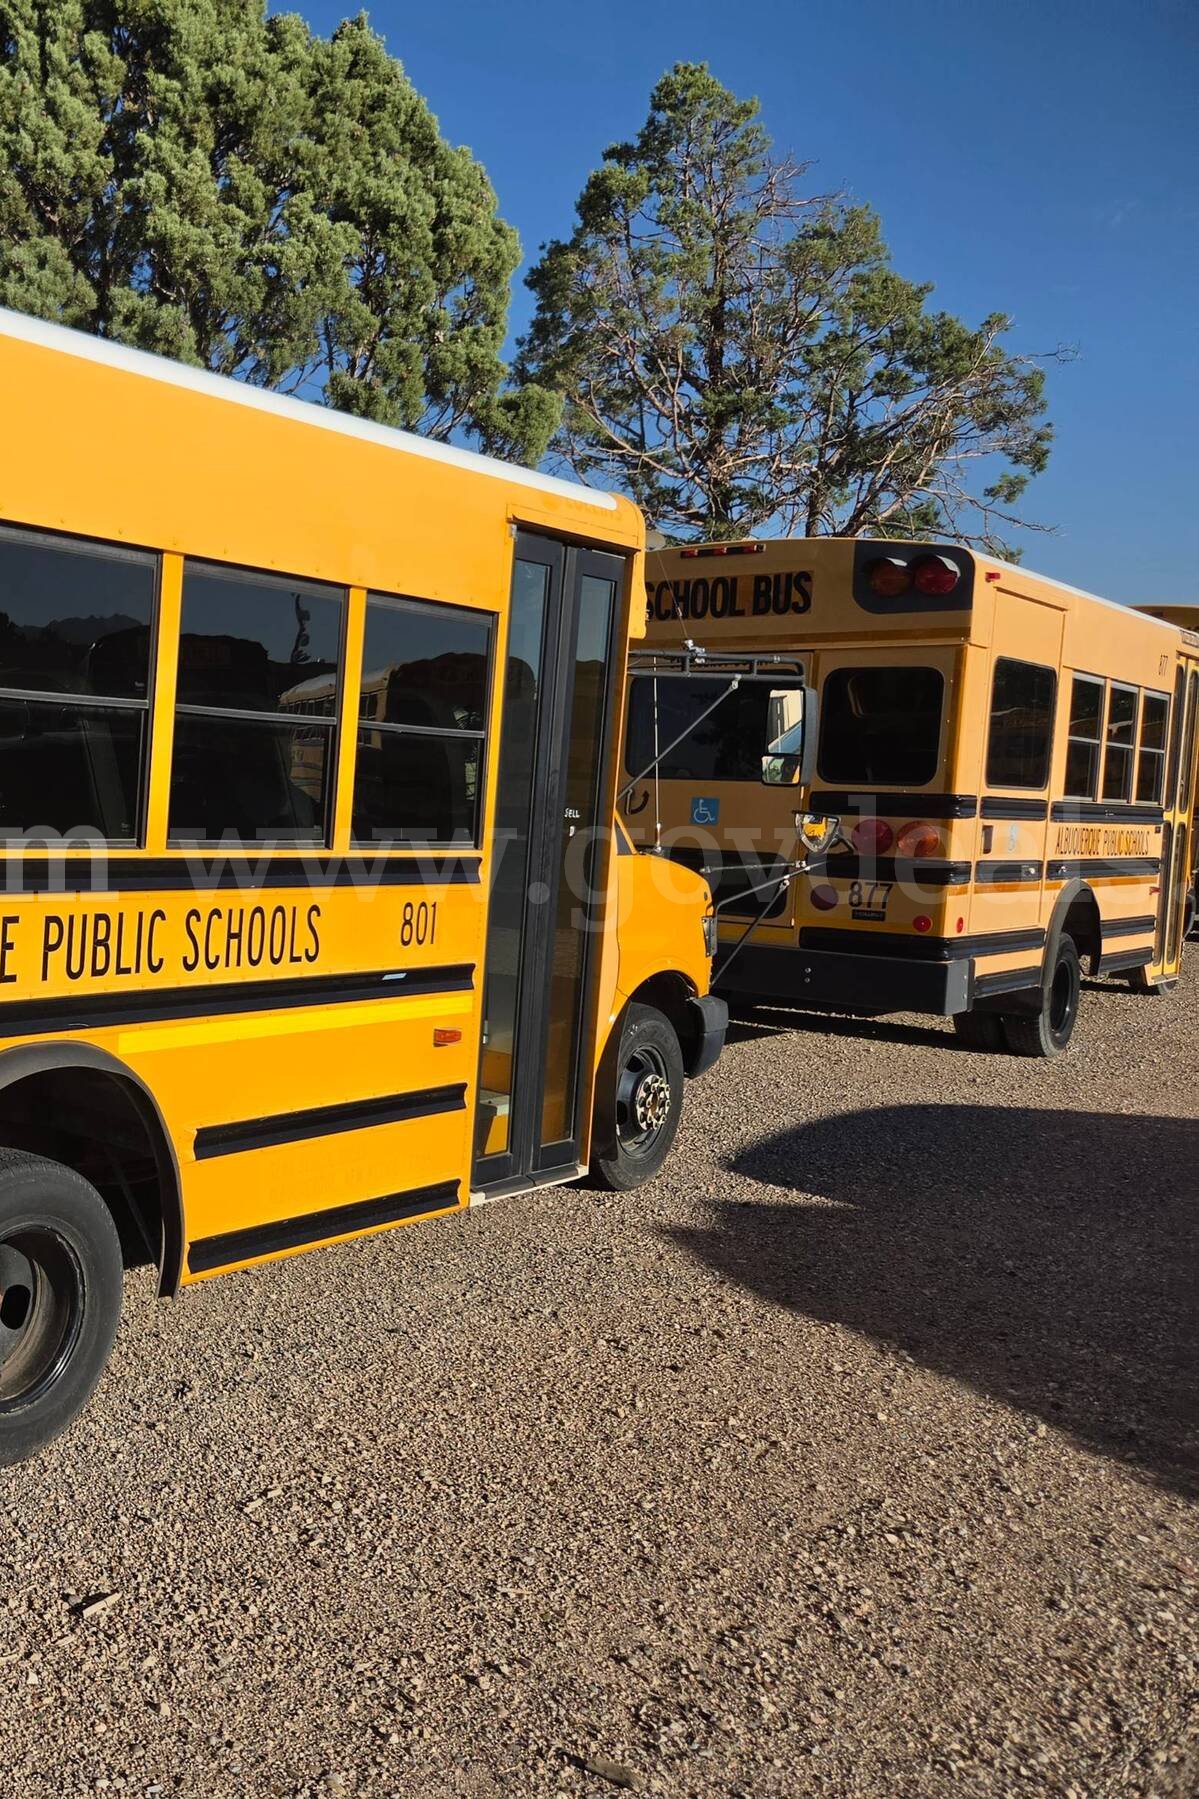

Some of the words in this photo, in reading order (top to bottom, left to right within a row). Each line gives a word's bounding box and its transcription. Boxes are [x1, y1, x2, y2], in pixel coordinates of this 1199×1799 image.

[752, 571, 812, 615] BUS
[1055, 827, 1101, 856] ALBUQUERQUE
[1102, 829, 1122, 856] PUBLIC
[1124, 830, 1150, 856] SCHOOLS
[848, 881, 894, 909] 877
[41, 909, 167, 982] PUBLIC
[182, 904, 321, 972] SCHOOLS
[401, 902, 437, 946] 801
